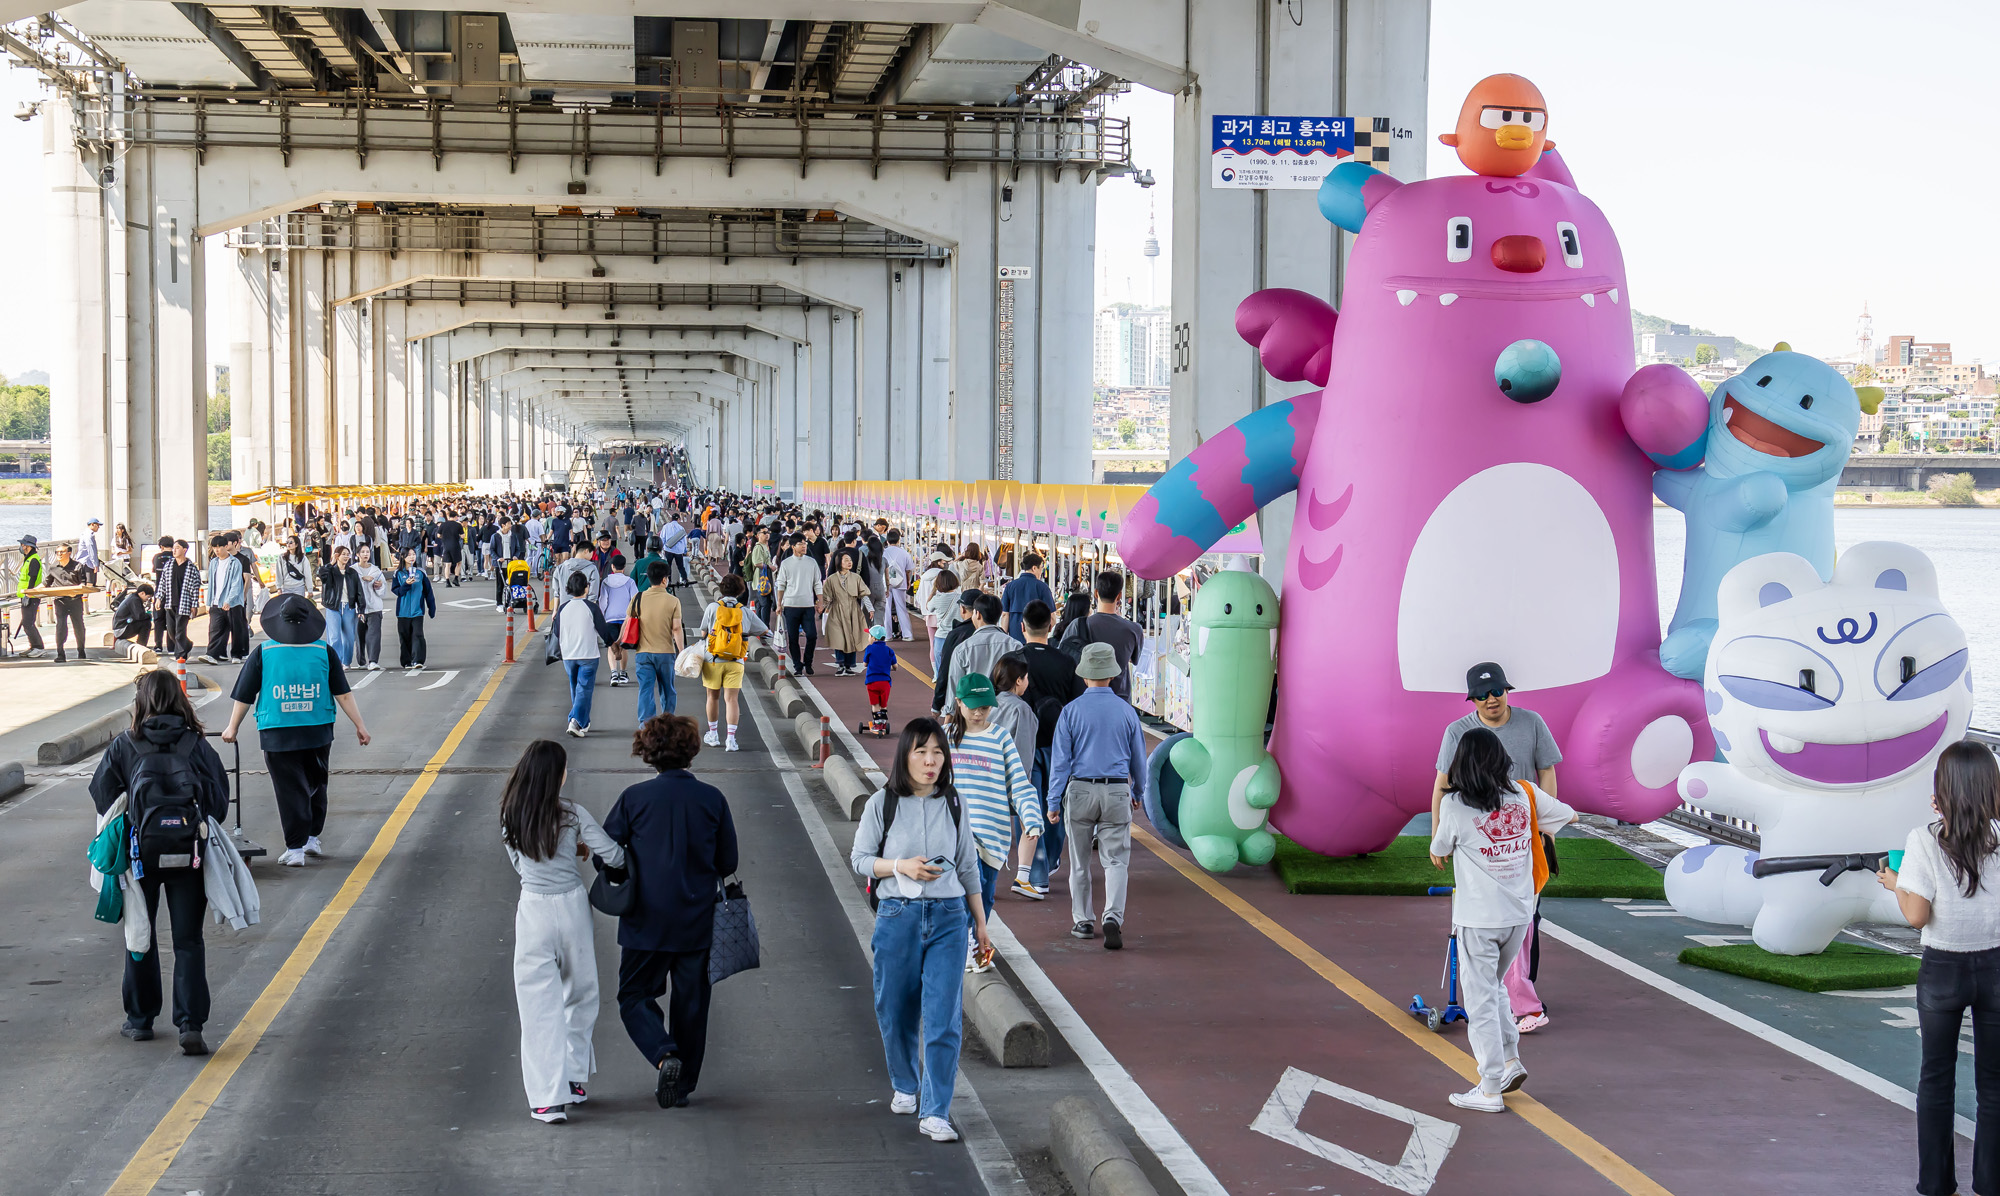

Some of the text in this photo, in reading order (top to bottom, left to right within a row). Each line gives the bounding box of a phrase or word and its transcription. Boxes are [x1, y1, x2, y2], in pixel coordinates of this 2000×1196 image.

[1222, 119, 1345, 137] 과거 최고 홍수위
[1392, 127, 1412, 139] 14m
[1295, 139, 1326, 147] 13.63m)
[1174, 322, 1189, 373] 38
[273, 684, 320, 700] 아,반납!
[285, 702, 310, 711] 다회용기
[1479, 843, 1511, 857] PASTA
